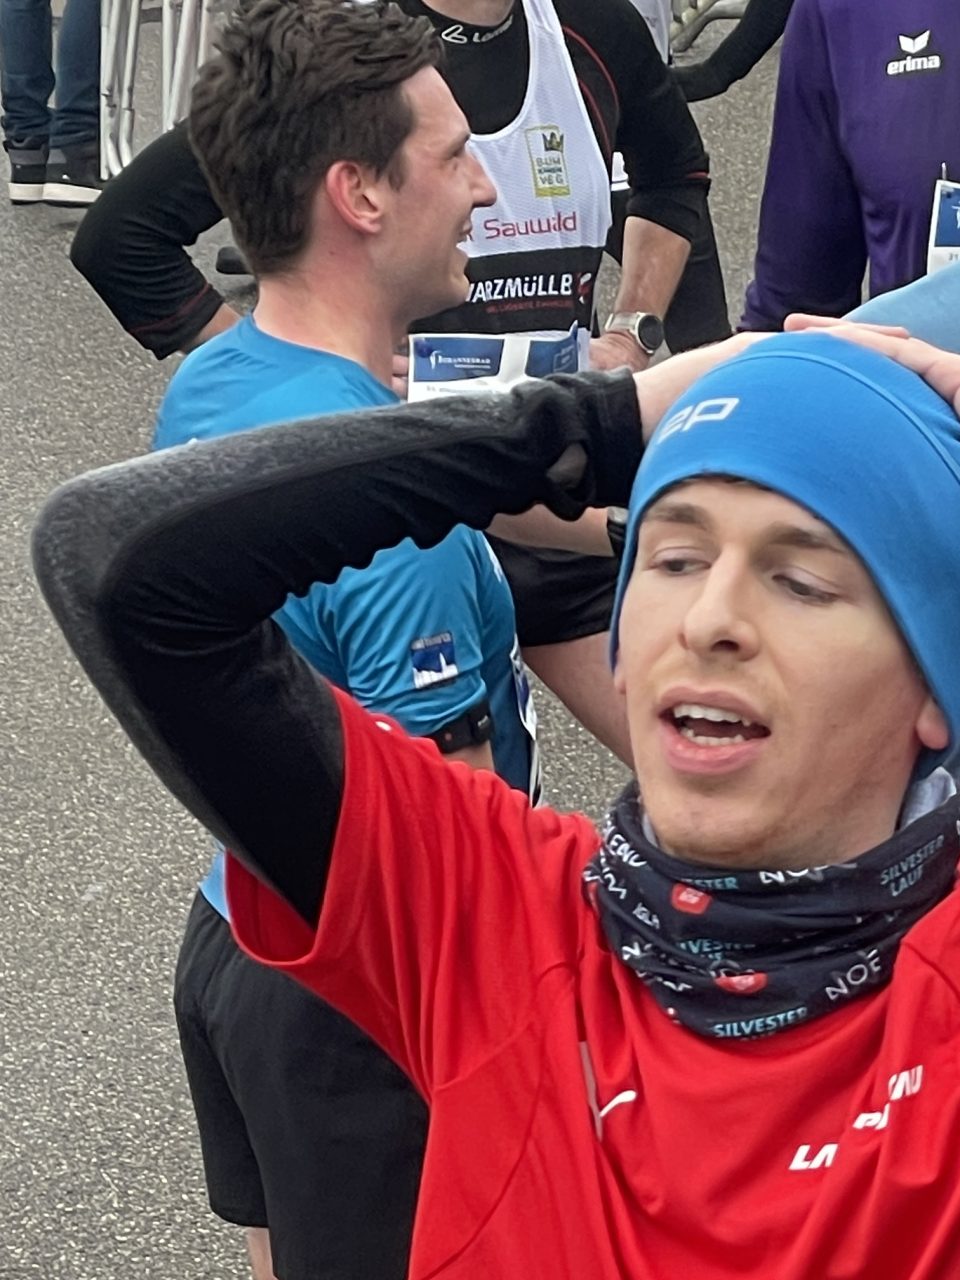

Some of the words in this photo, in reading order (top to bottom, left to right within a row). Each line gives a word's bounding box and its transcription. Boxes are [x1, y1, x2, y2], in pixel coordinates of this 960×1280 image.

[887, 55, 941, 75] erima
[881, 834, 945, 885] SILVESTER
[713, 1006, 808, 1038] SILVESTER
